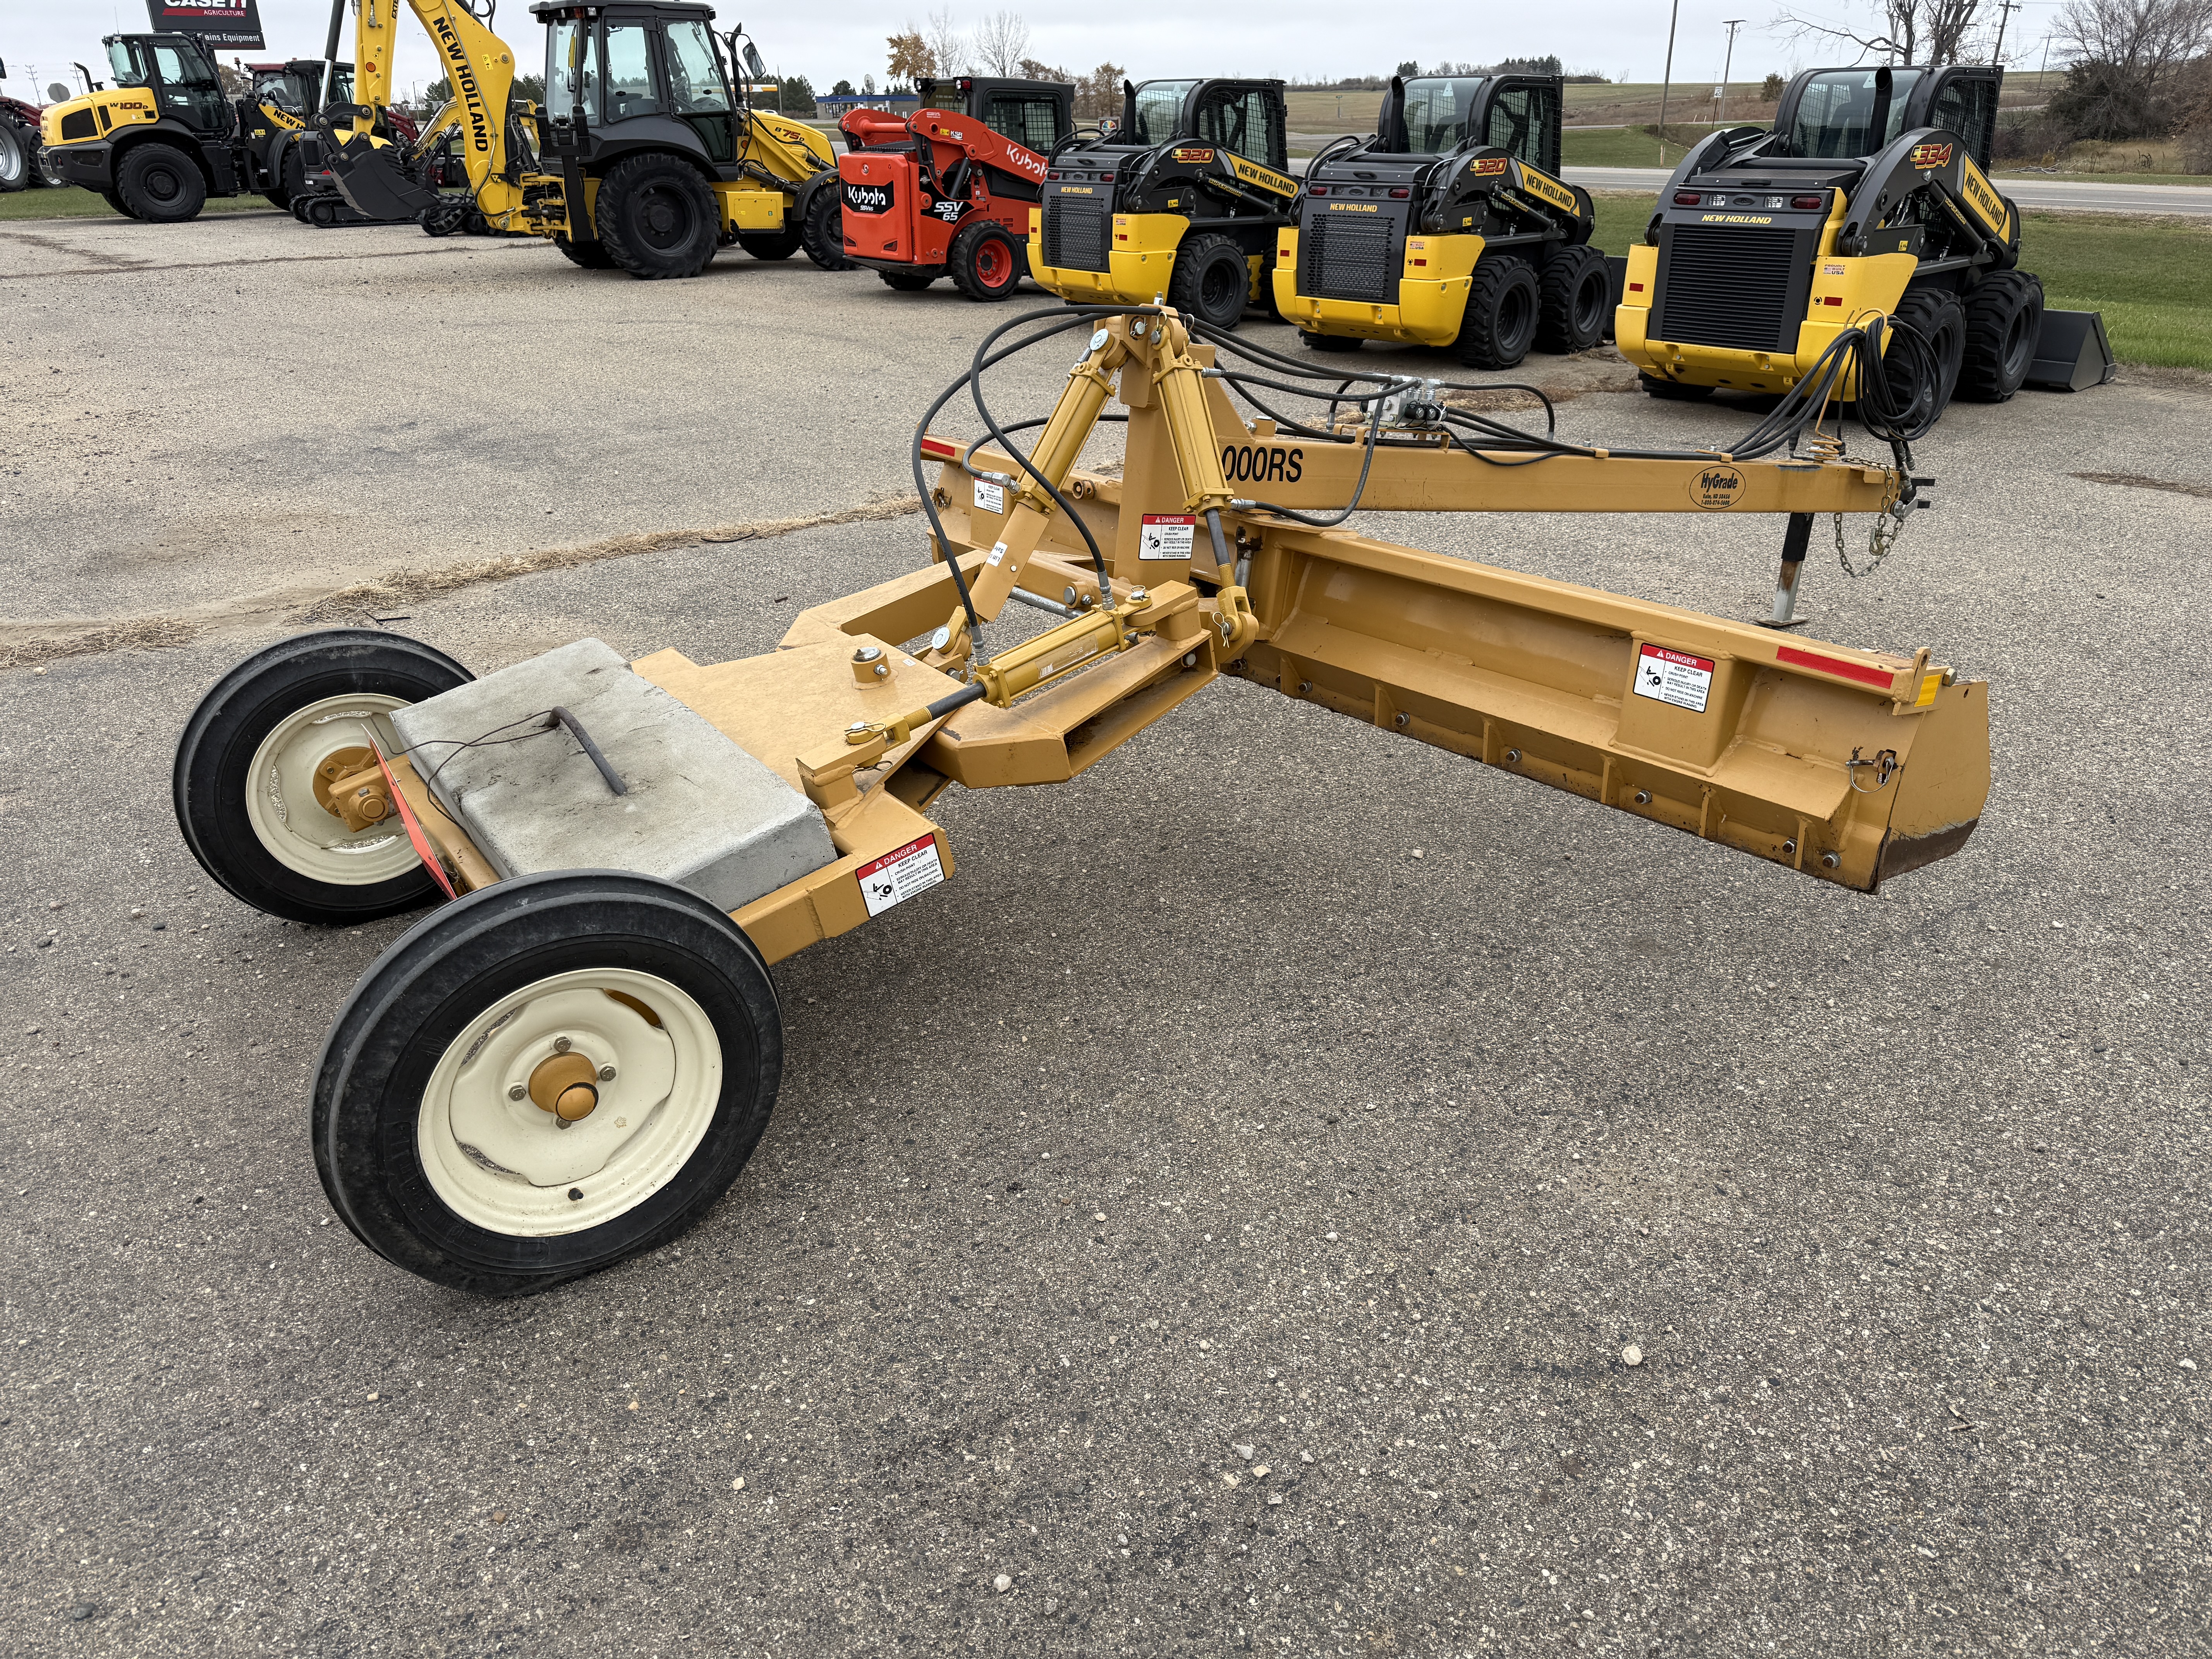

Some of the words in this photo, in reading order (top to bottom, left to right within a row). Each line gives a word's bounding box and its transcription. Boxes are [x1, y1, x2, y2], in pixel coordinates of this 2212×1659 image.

[222, 33, 260, 43] Equipment
[433, 16, 465, 60] NEW
[455, 65, 488, 151] HOLLAND
[273, 110, 296, 126] NEW
[1238, 163, 1259, 179] NEW
[1258, 173, 1295, 194] HOLLAND
[848, 186, 886, 205] Kubota
[1526, 173, 1543, 191] NEW
[1542, 183, 1572, 207] HOLLAND
[934, 202, 964, 212] SSV
[1965, 173, 1981, 199] NEW
[1978, 186, 2003, 225] HOLLAND
[943, 212, 958, 221] 65
[1346, 204, 1377, 212] HOLLAND
[1725, 215, 1772, 224] HOLLAND
[1700, 472, 1738, 493] HyGrade
[1665, 652, 1697, 666] DANGER
[884, 844, 917, 865] DANGER
[898, 859, 910, 867] KEEP
[912, 850, 927, 860] CLEAR
